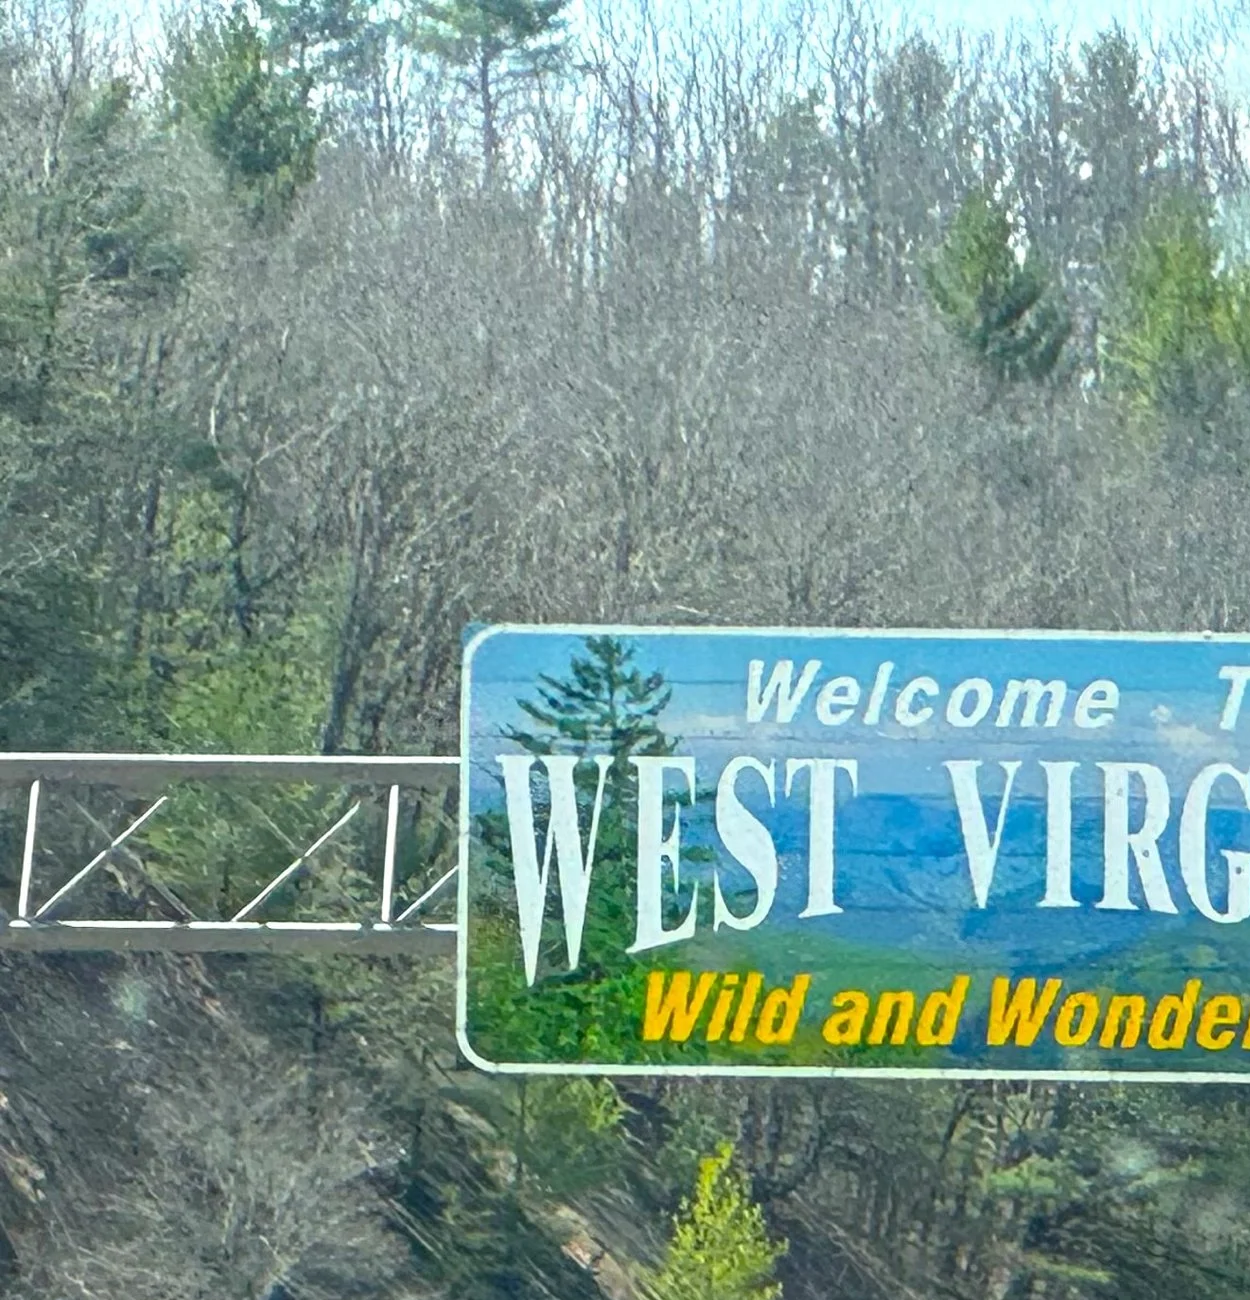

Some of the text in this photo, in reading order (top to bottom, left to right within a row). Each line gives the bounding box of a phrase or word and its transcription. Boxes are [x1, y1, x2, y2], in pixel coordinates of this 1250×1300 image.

[746, 659, 1120, 728] Welcome
[495, 755, 858, 987] WEST
[642, 970, 812, 1045] Wild
[823, 975, 969, 1047] and
